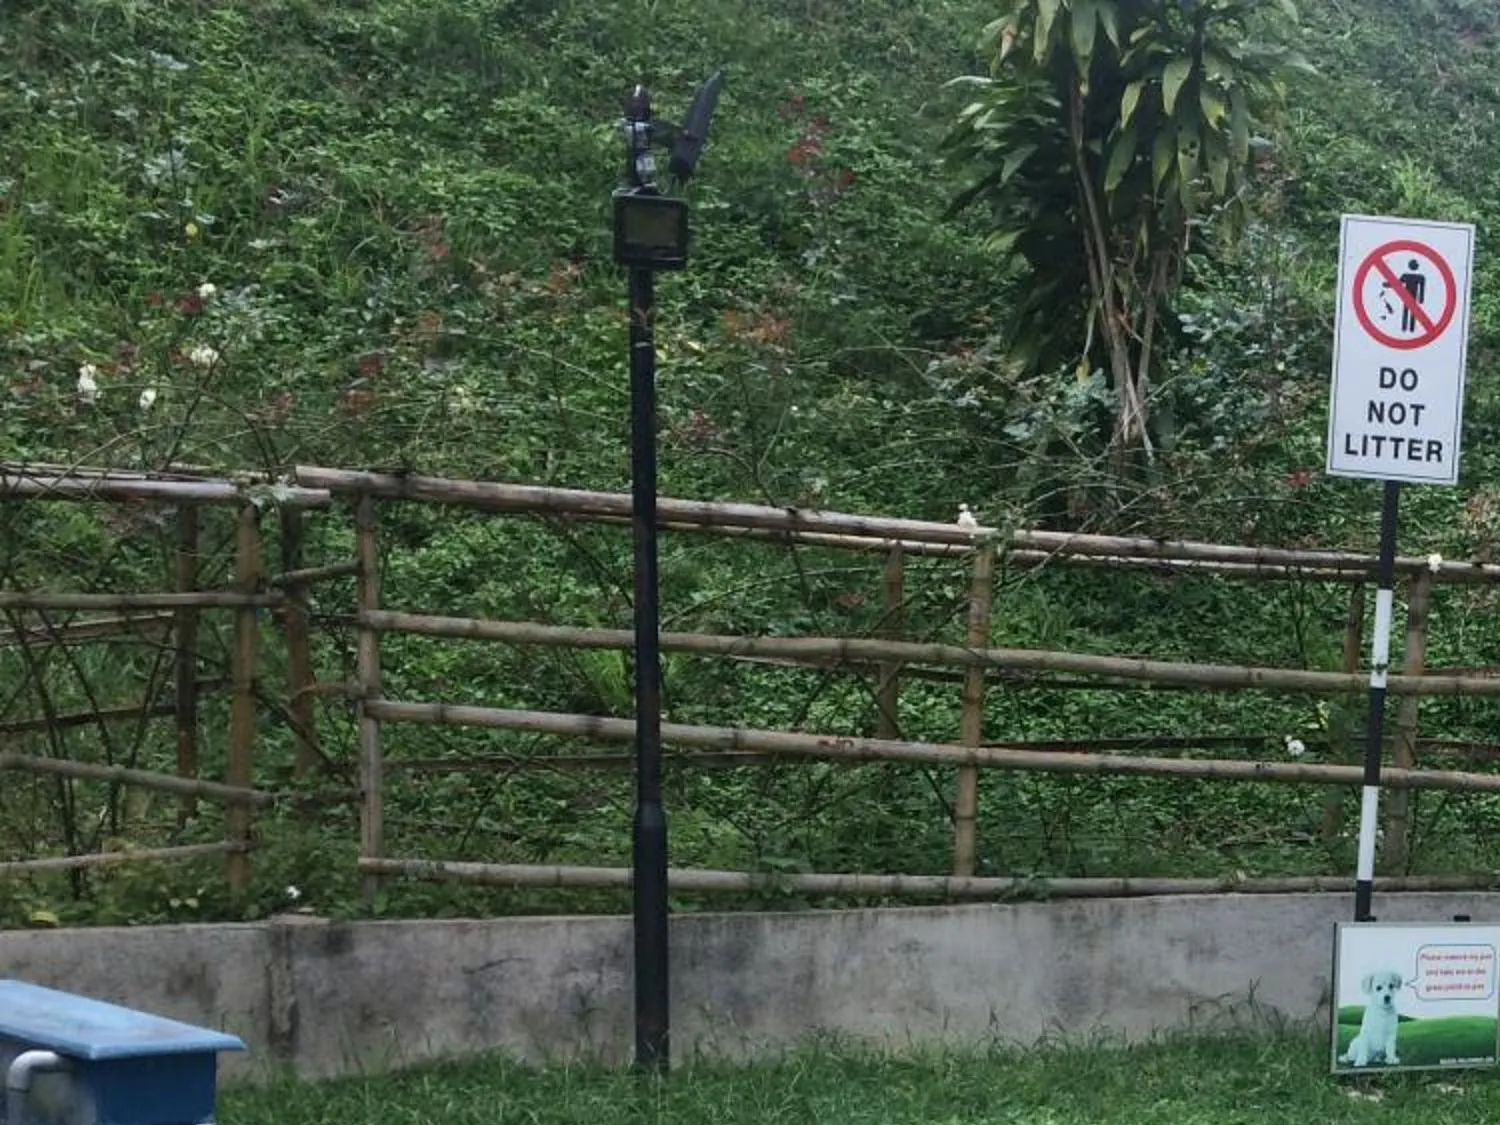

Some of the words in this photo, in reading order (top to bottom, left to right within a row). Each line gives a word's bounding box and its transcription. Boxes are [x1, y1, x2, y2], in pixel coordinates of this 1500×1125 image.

[1379, 366, 1418, 391] DO
[1367, 400, 1425, 427] NOT
[1343, 433, 1444, 462] LITTER
